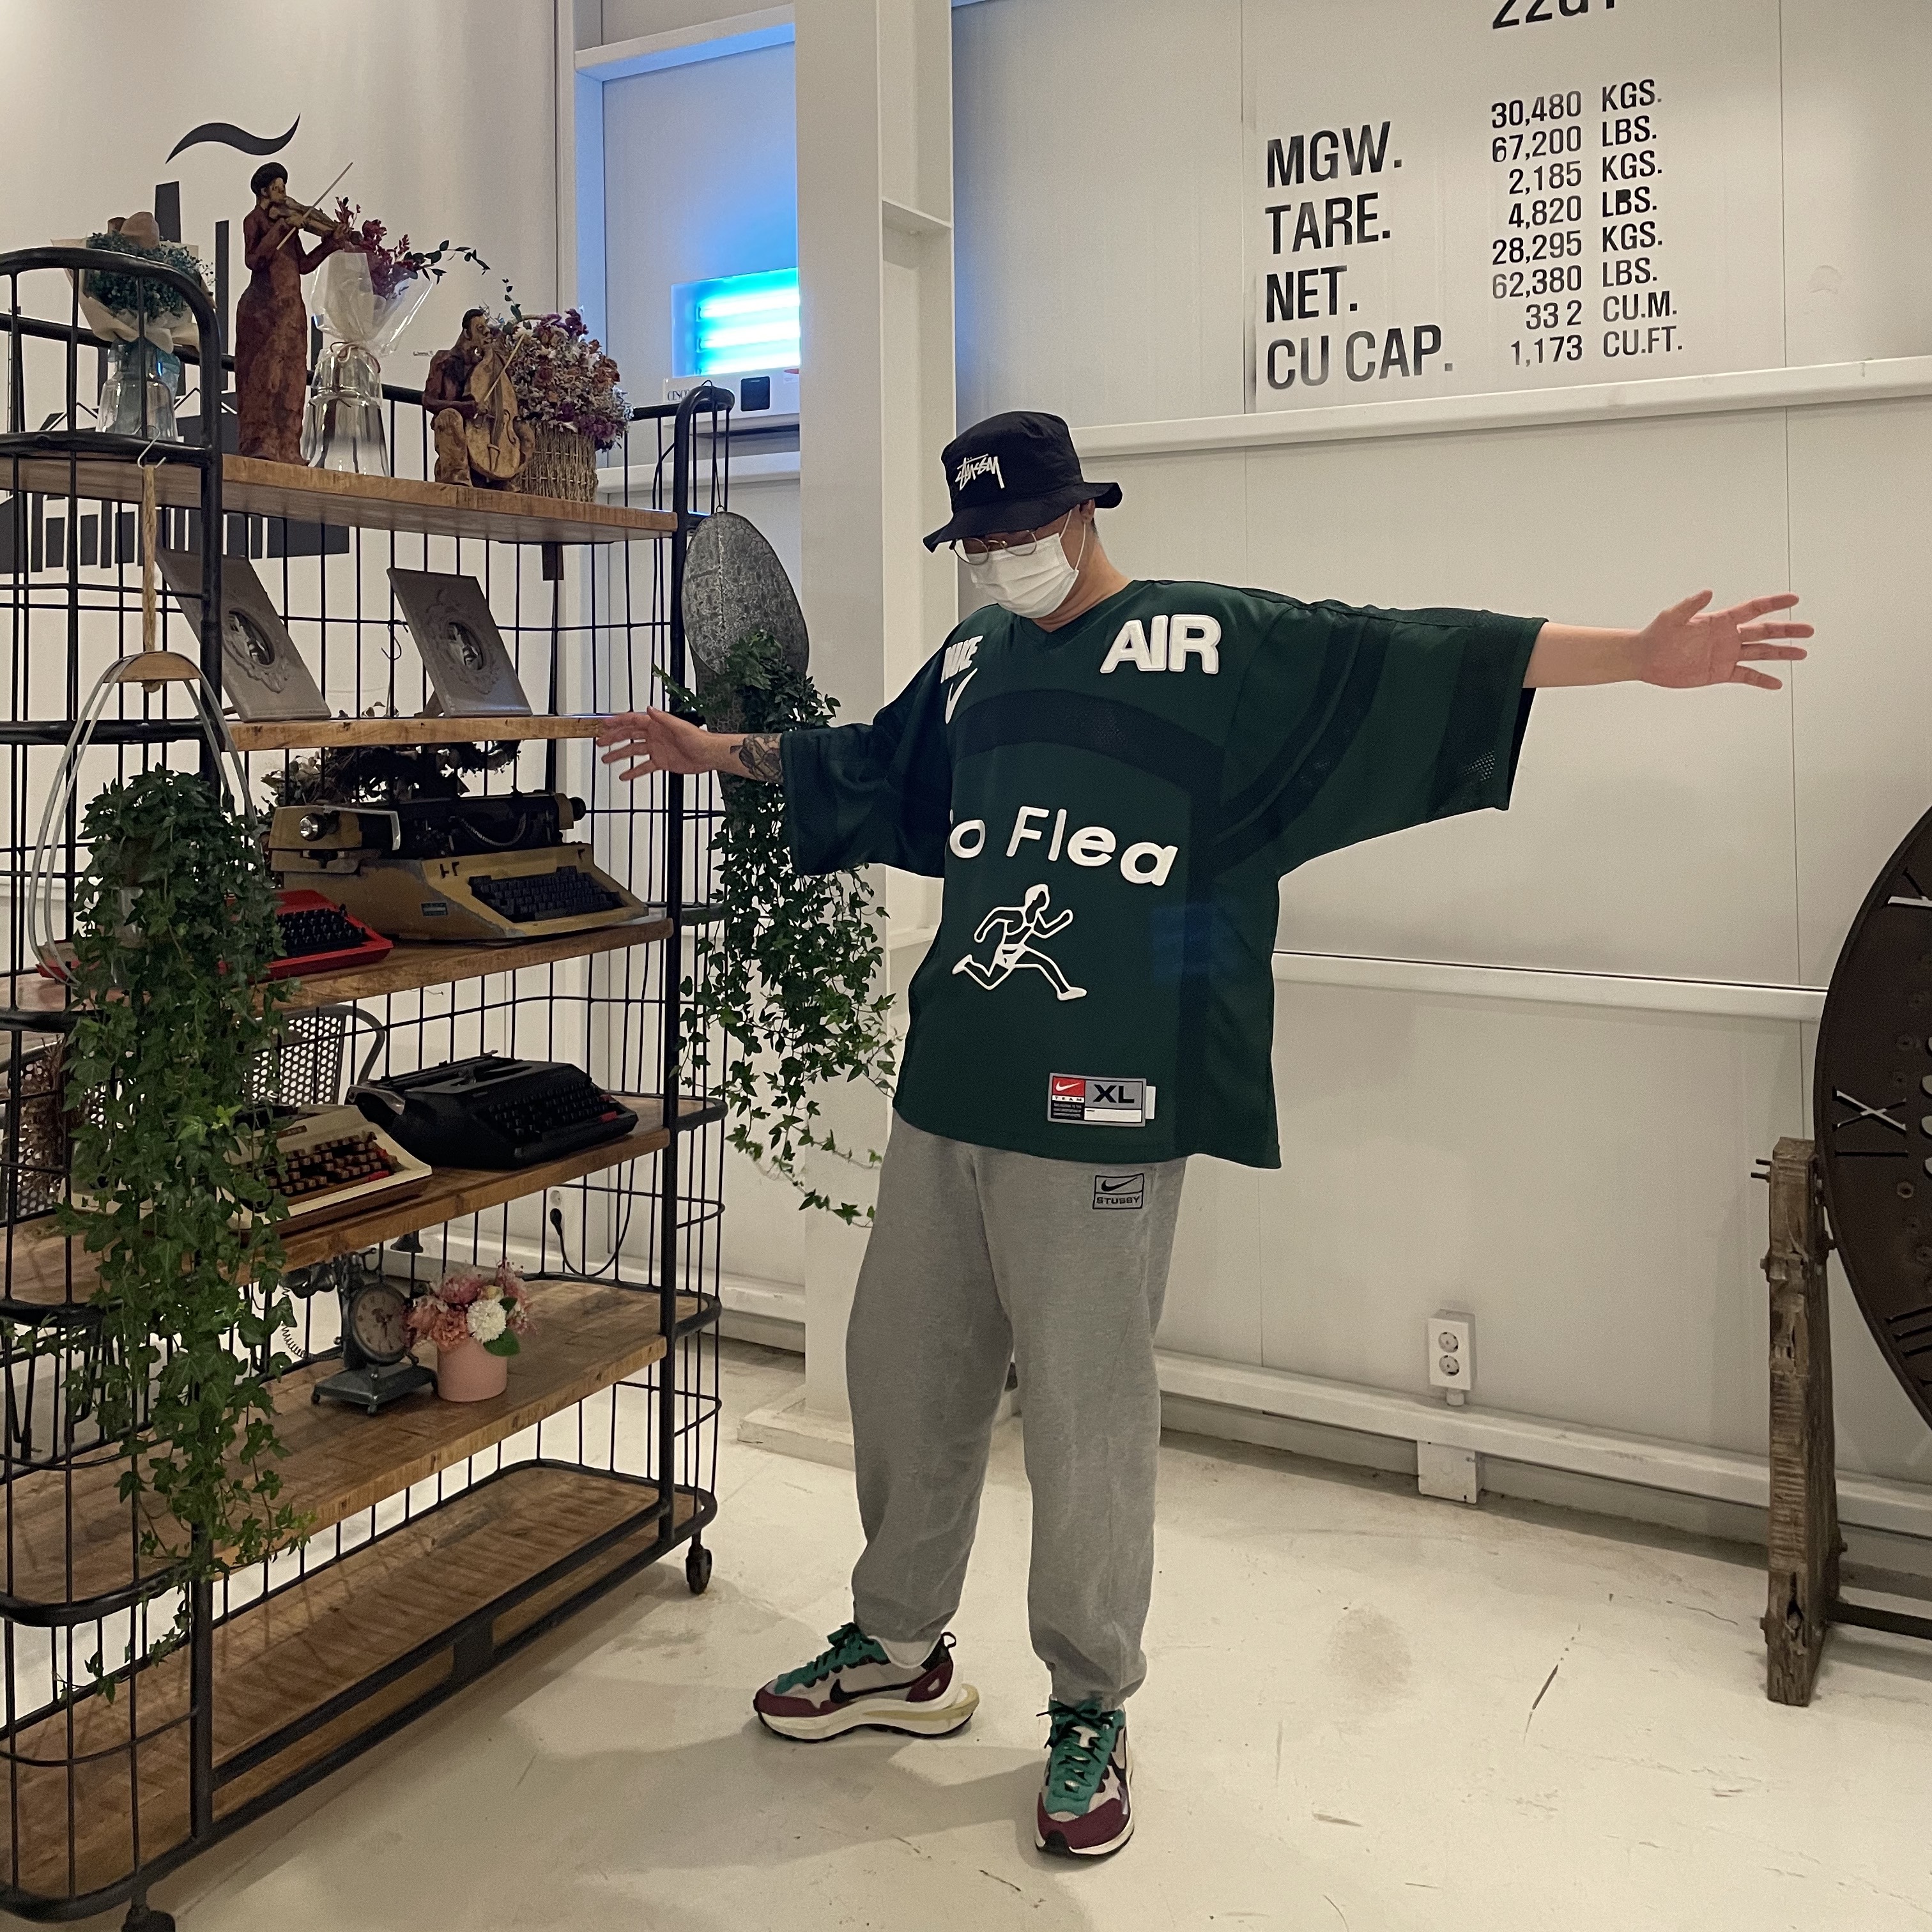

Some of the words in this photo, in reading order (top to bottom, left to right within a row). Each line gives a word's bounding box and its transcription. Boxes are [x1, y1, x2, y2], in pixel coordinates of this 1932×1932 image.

[1491, 91, 1582, 128] 30,480
[1602, 79, 1663, 112] KGS.
[1267, 121, 1402, 188] MGW.
[1492, 126, 1582, 162] 67,200
[1602, 115, 1657, 147] LBS.
[1508, 160, 1582, 195] 2,185
[1602, 150, 1663, 182] KGS.
[1265, 192, 1391, 254] TARE.
[1508, 195, 1582, 229] 4,820
[1602, 186, 1657, 218] LBS.
[1492, 231, 1582, 265] 28,295
[1602, 221, 1663, 252] KGS.
[1266, 265, 1358, 323] NET.
[1492, 265, 1582, 299] 62,380
[1602, 257, 1658, 288] LBS.
[1603, 291, 1677, 322] CU.M.
[1511, 334, 1583, 367] 1,173
[1603, 325, 1683, 357] CU.FT.
[940, 635, 983, 684] NIKE
[1100, 615, 1222, 674] AIR
[1006, 806, 1178, 886] Flea
[1092, 1084, 1135, 1104] XL
